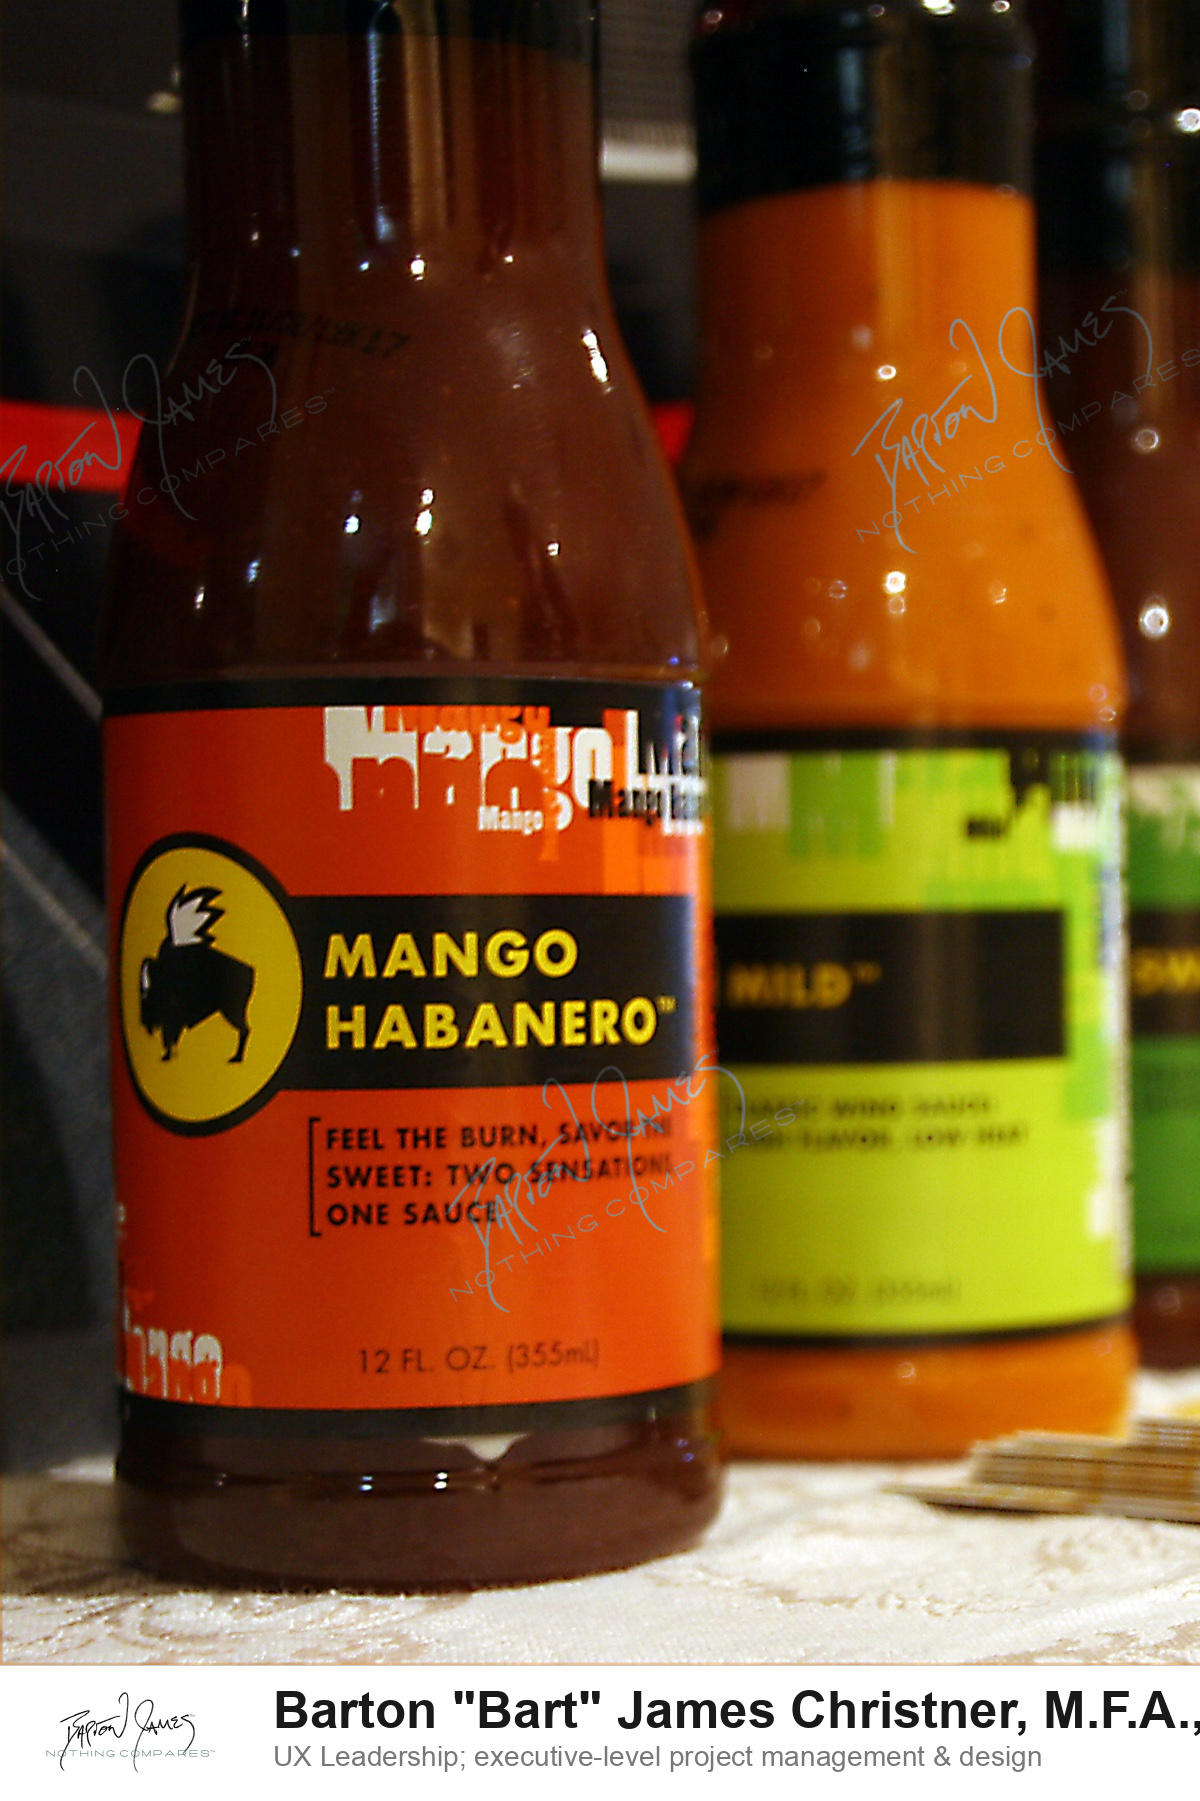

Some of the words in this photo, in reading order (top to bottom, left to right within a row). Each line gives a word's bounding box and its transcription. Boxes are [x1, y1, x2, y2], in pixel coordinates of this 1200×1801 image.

[477, 805, 545, 835] Mango
[324, 929, 579, 978] MANGO
[327, 1128, 385, 1150] FEEL
[397, 1127, 448, 1149] THE
[461, 1125, 547, 1150] BURN,
[328, 1164, 432, 1188] SWEET:
[447, 1162, 515, 1186] TWO
[328, 1202, 389, 1227] ONE
[361, 1349, 391, 1374] 12
